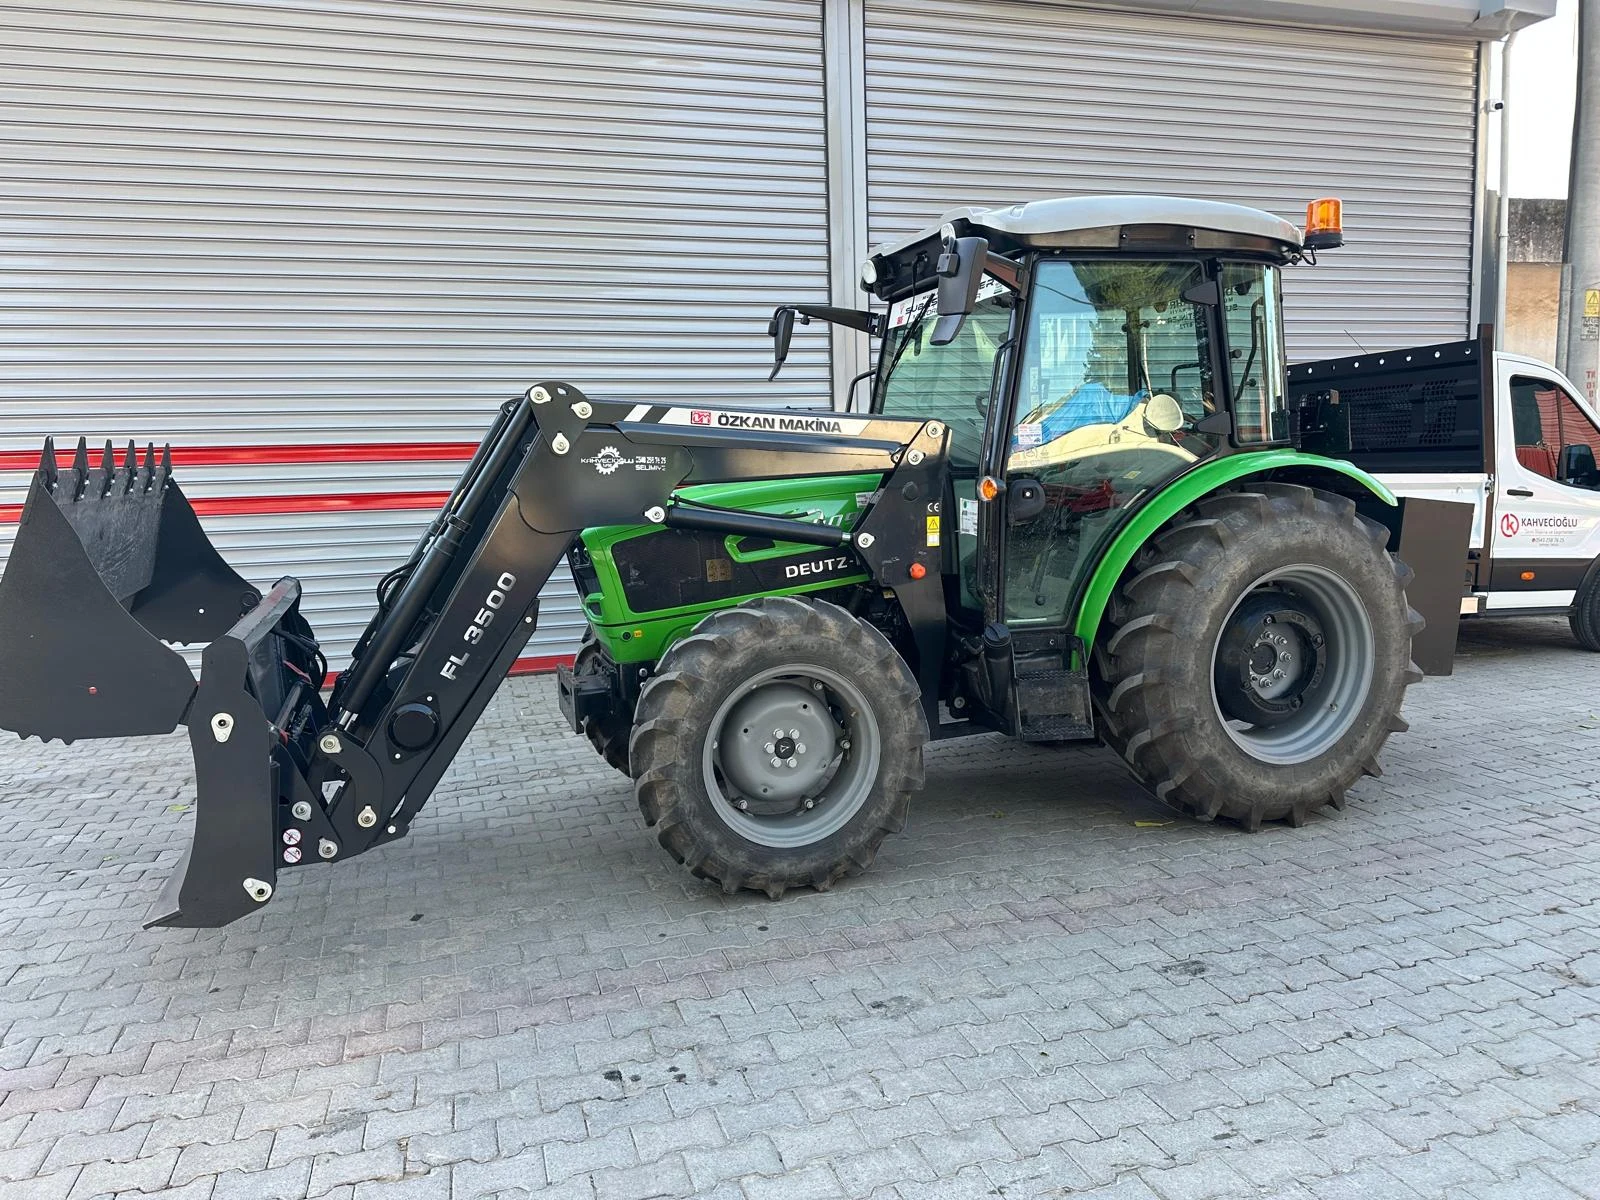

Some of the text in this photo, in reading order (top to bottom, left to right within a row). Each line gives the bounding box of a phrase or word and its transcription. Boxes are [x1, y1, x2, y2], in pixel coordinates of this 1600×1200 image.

[717, 412, 775, 430] ÖZKAN
[779, 418, 842, 433] MAKİNA
[1521, 516, 1578, 527] KAHVECİOĞLU
[440, 571, 517, 681] FL 3500
